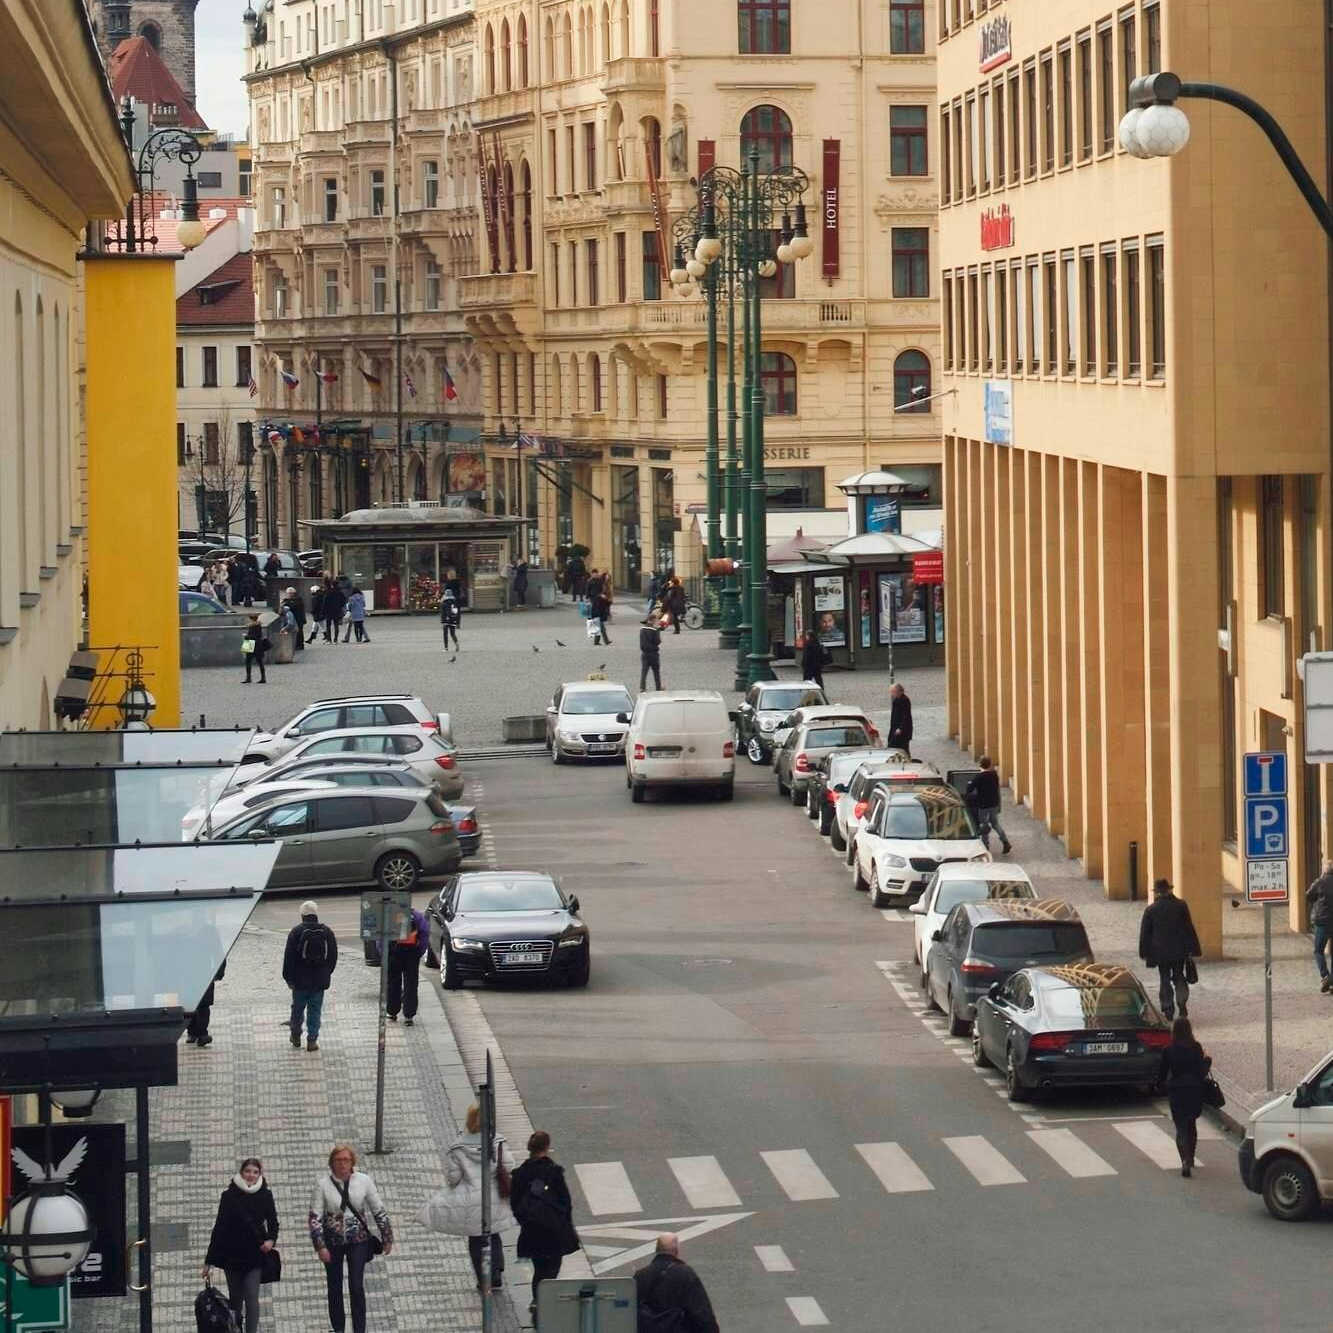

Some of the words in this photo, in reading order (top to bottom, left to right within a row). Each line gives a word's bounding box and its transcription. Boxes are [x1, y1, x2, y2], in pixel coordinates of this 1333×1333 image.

[826, 187, 837, 229] HOTEL
[736, 447, 811, 460] RSSERIE
[1255, 805, 1279, 839] P
